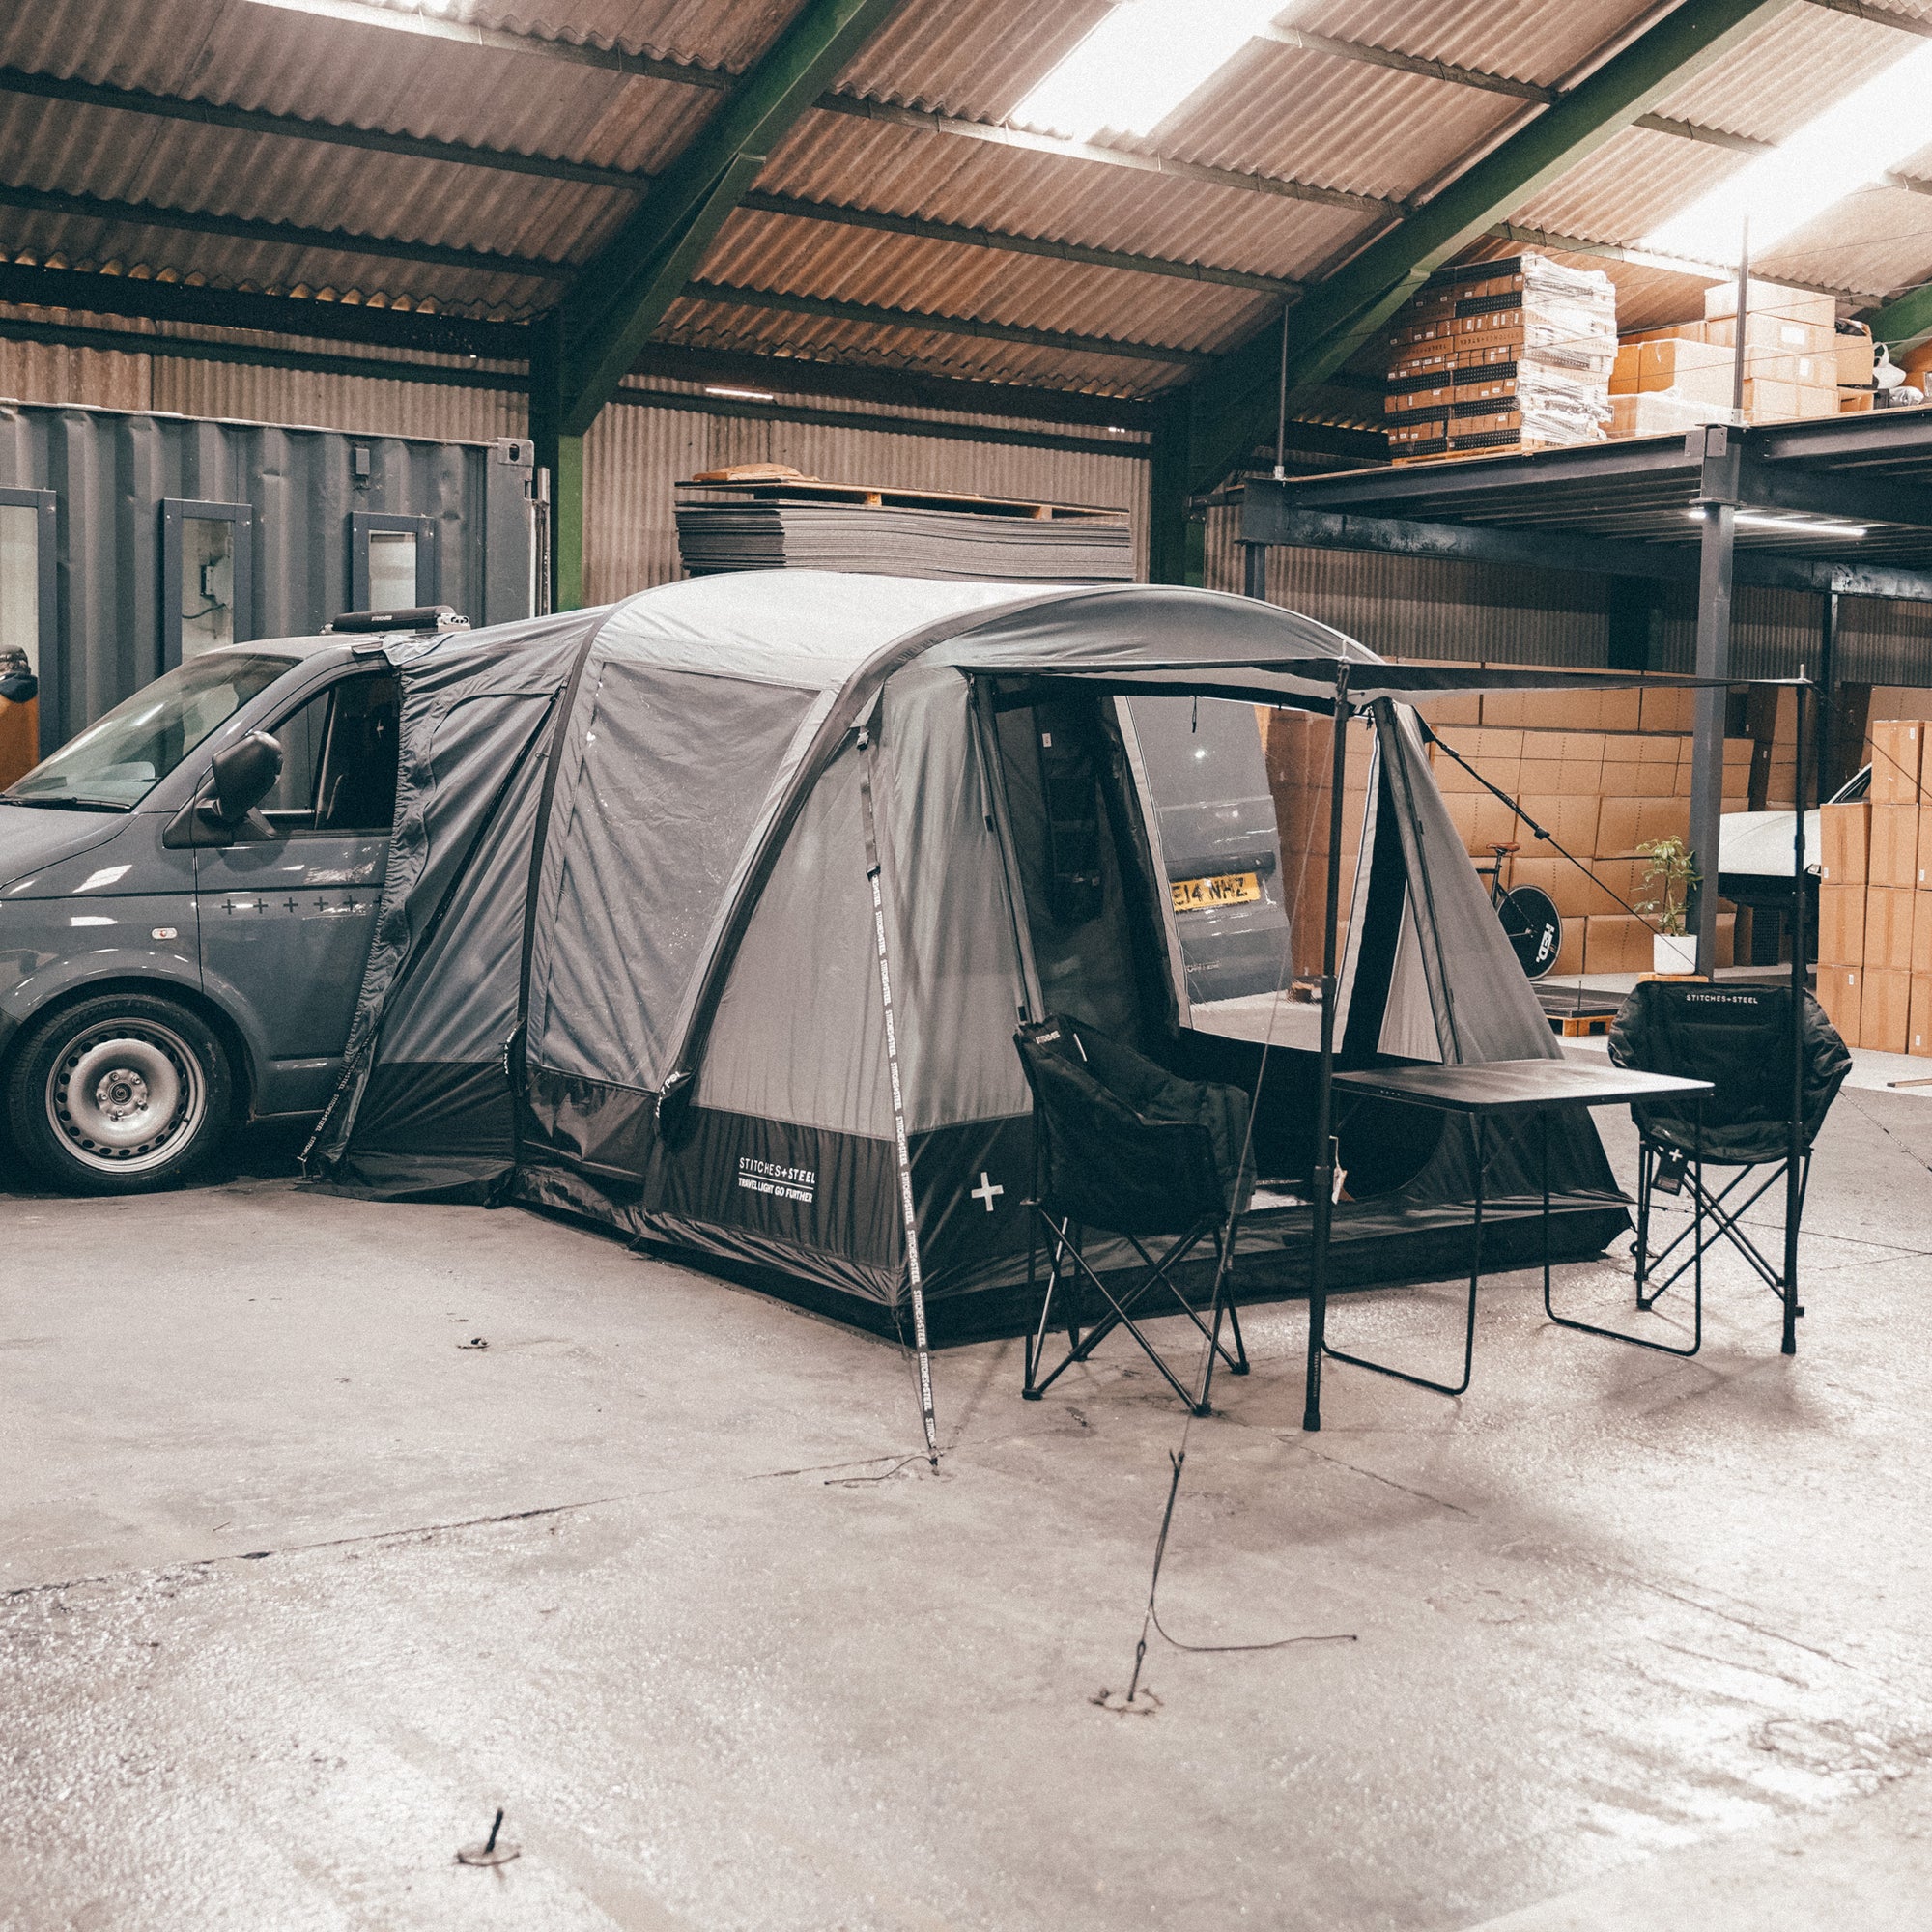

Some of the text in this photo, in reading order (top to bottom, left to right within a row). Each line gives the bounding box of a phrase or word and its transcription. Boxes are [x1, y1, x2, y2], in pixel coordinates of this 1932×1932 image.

[1686, 994, 1758, 1004] STITCHES+STEEL
[738, 1156, 815, 1184] STITCHES+STEEL
[738, 1177, 813, 1203] TRAVEL LIGHT GO FURTHER
